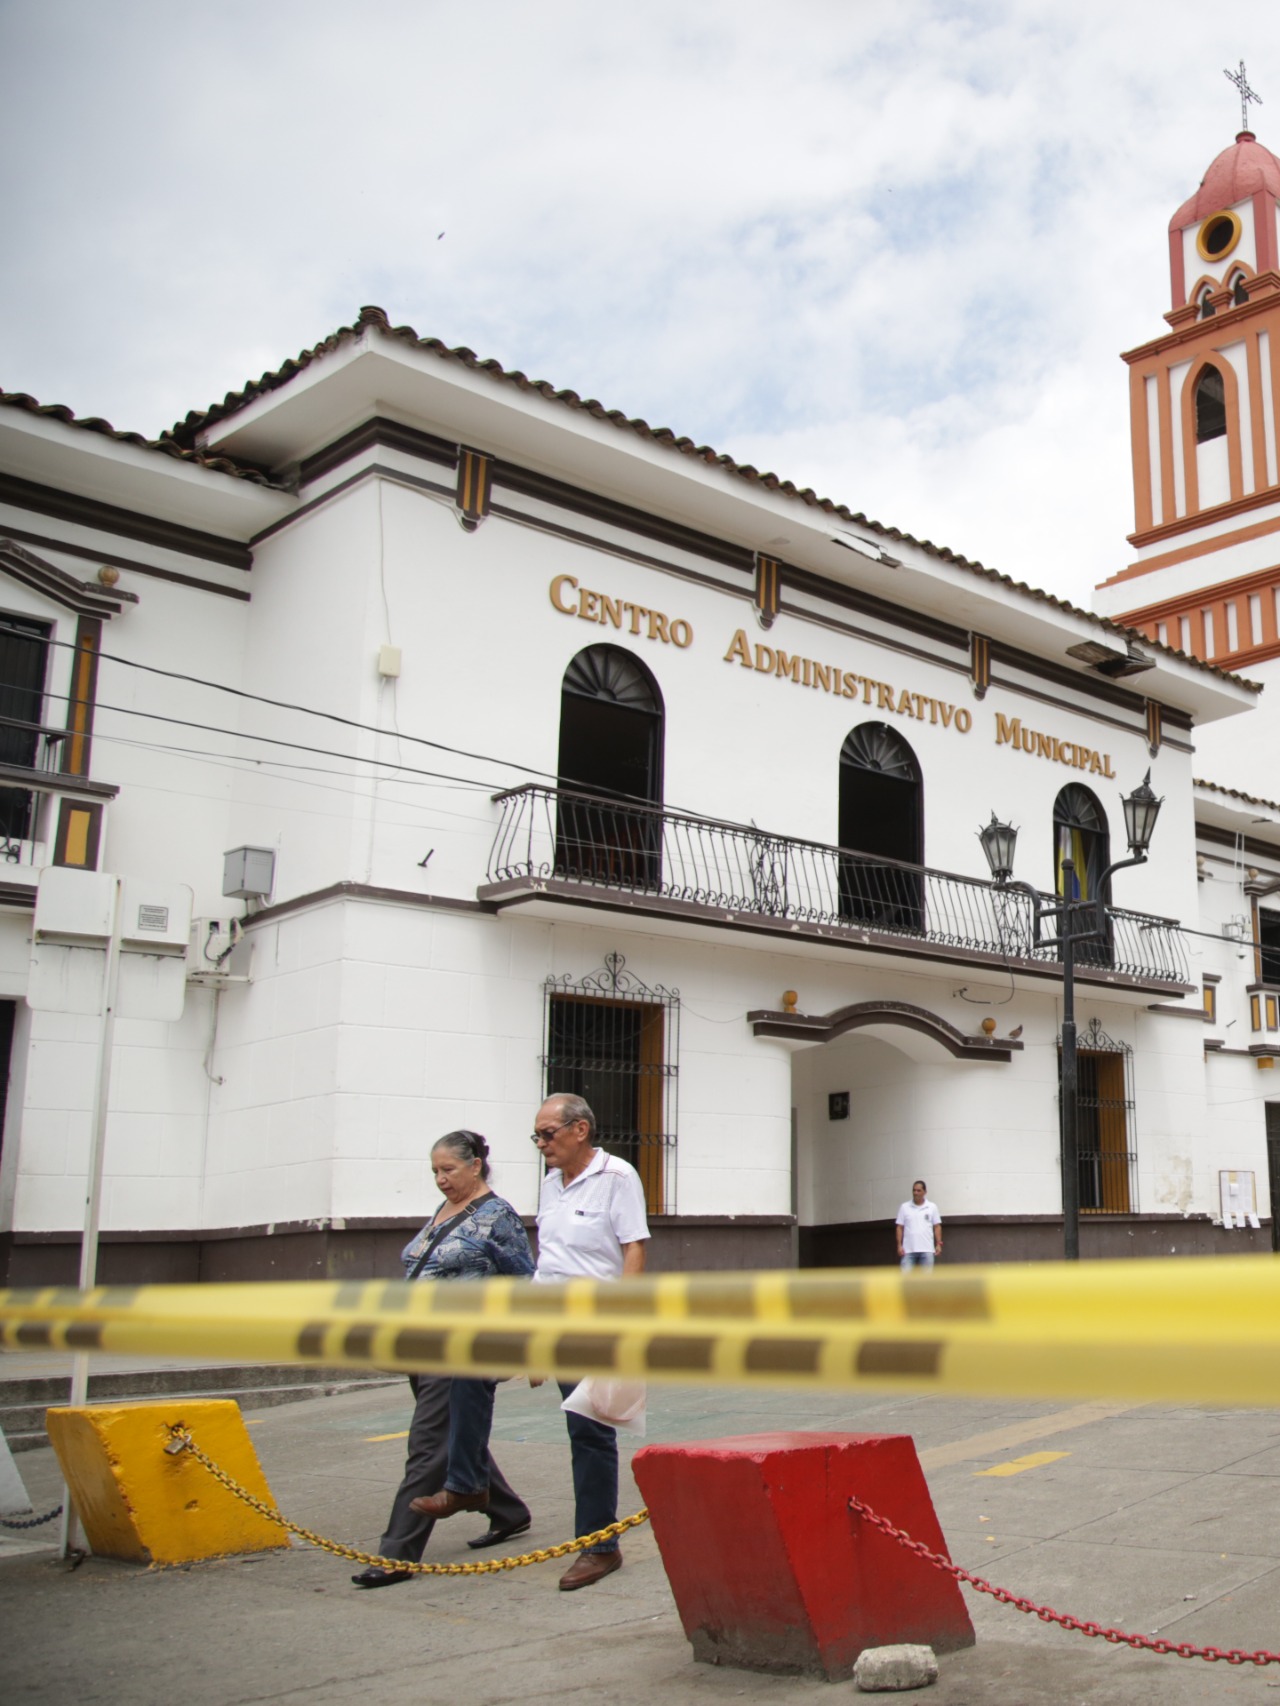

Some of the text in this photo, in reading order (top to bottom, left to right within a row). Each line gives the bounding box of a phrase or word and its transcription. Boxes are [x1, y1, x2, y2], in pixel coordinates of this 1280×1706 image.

[549, 574, 1117, 780] CENTRO ADMINISTRATIVO MUNICIPAL
